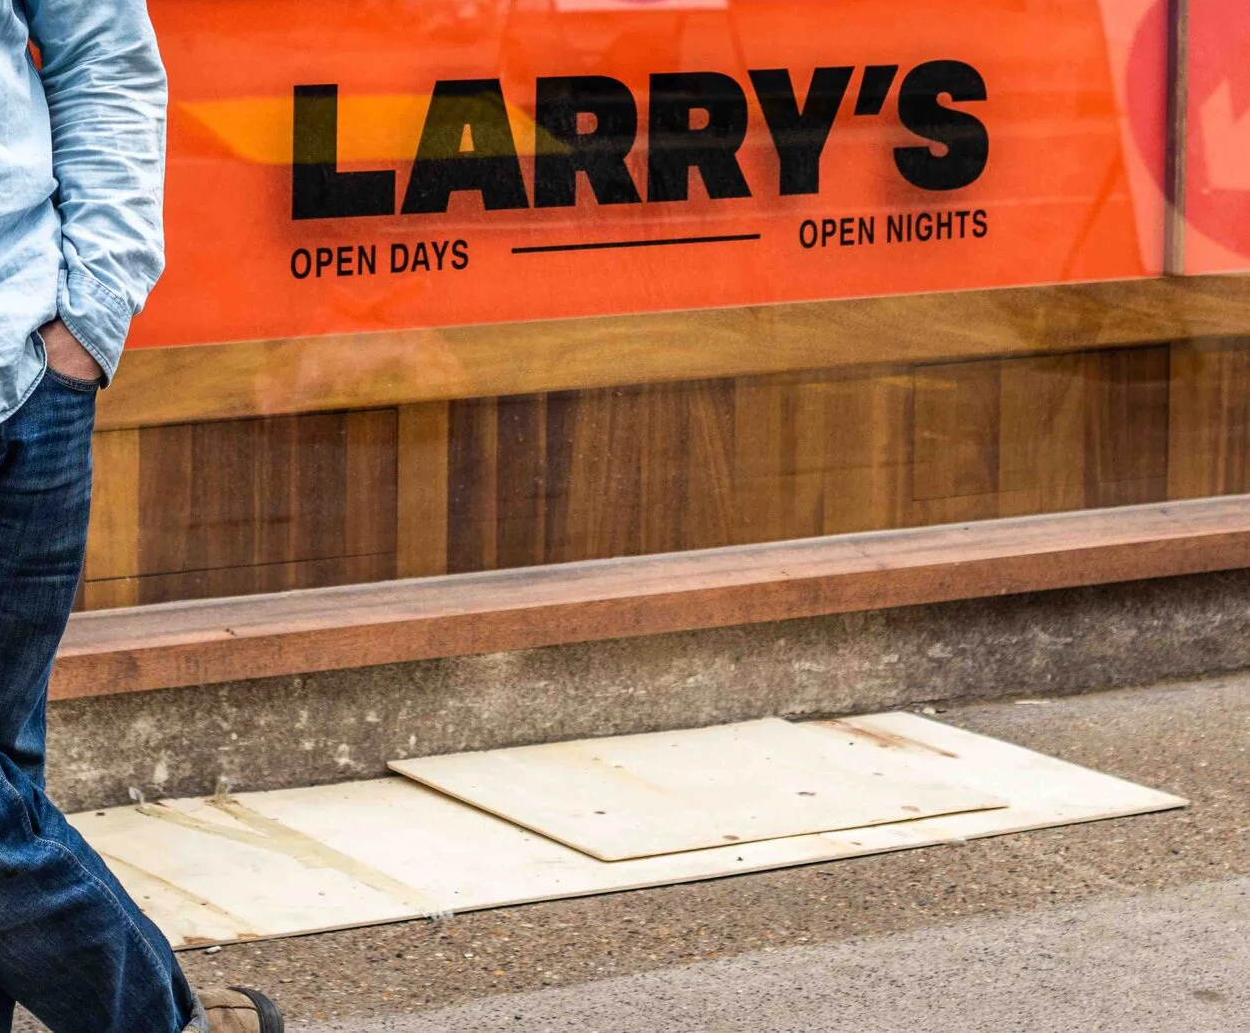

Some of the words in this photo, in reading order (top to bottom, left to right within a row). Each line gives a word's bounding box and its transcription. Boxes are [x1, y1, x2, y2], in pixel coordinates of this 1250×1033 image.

[291, 59, 990, 221] LARRY'S
[798, 215, 876, 249] OPEN
[886, 209, 989, 243] NIGHTS
[290, 244, 377, 280] OPEN
[389, 239, 470, 274] DAYS
